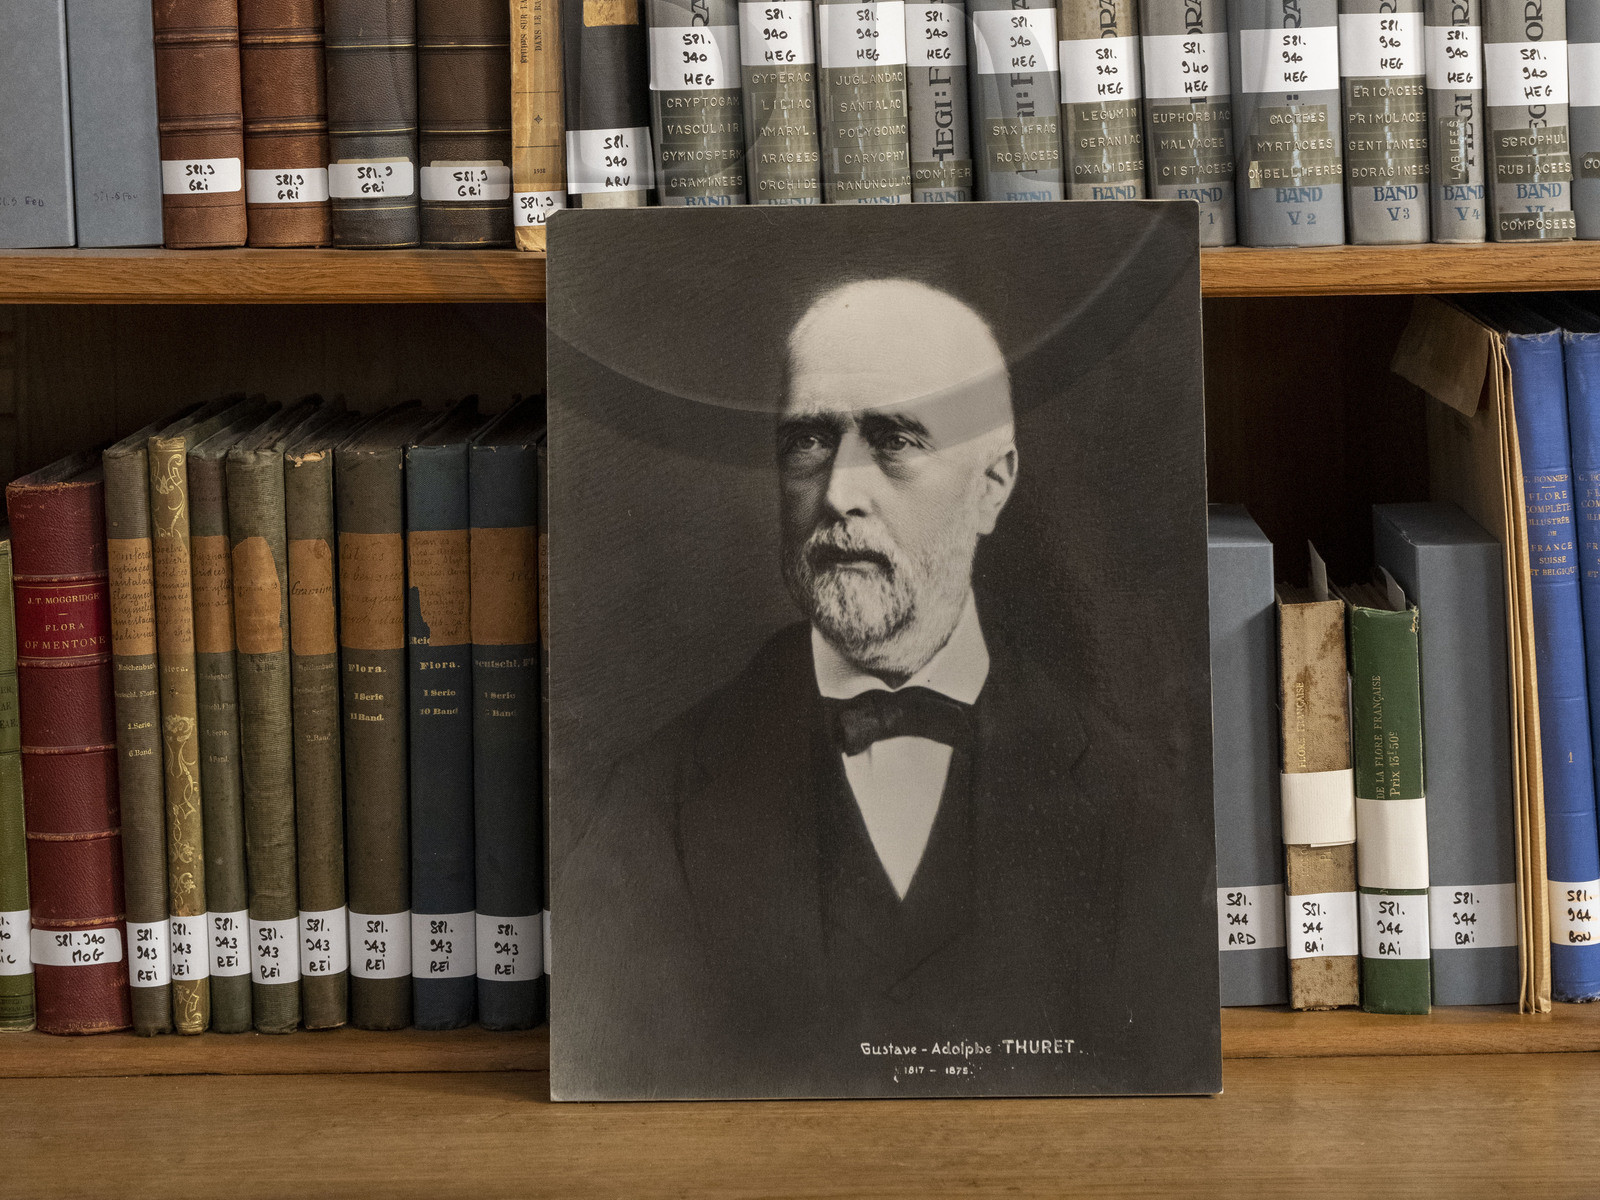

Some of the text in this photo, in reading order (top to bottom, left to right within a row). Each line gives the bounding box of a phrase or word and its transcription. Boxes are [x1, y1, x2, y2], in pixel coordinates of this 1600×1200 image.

[684, 73, 714, 85] HEG
[752, 72, 811, 84] CYPERAC
[1353, 85, 1424, 98] ERICACEES
[1524, 85, 1553, 99] HEG
[840, 100, 901, 113] SANTALAC
[1082, 108, 1137, 121] LEGUMIN
[667, 123, 739, 135] VASCULAIR
[1257, 139, 1333, 152] MYRTACEES
[844, 151, 905, 165] CARYOPHY
[997, 150, 1059, 162] ROSACEES
[916, 167, 971, 180] CONIFER
[1162, 163, 1233, 176] CISTACEES
[1352, 164, 1430, 178] BORAGINEES
[1498, 162, 1571, 175] RUBIACEES
[671, 176, 743, 188] GRAMINEES
[1373, 185, 1418, 202] BAND
[1387, 206, 1410, 221] V 3
[1501, 216, 1576, 232] COMPOSEES
[1529, 490, 1567, 500] FLORE
[1532, 542, 1573, 551] FRANCE
[1540, 556, 1567, 564] SUISSE
[45, 592, 99, 605] MOGGRIDGE
[45, 622, 85, 632] FLORA
[25, 636, 105, 650] OF MENTONE
[348, 664, 387, 673] Flora.
[420, 661, 461, 671] Flora.
[1372, 675, 1385, 766] FLORE FRANÇAISE
[1389, 771, 1400, 797] Prix
[1229, 933, 1256, 945] ARD
[1569, 931, 1591, 943] BON
[860, 1042, 917, 1055] Gustave
[904, 1066, 924, 1075] 1817
